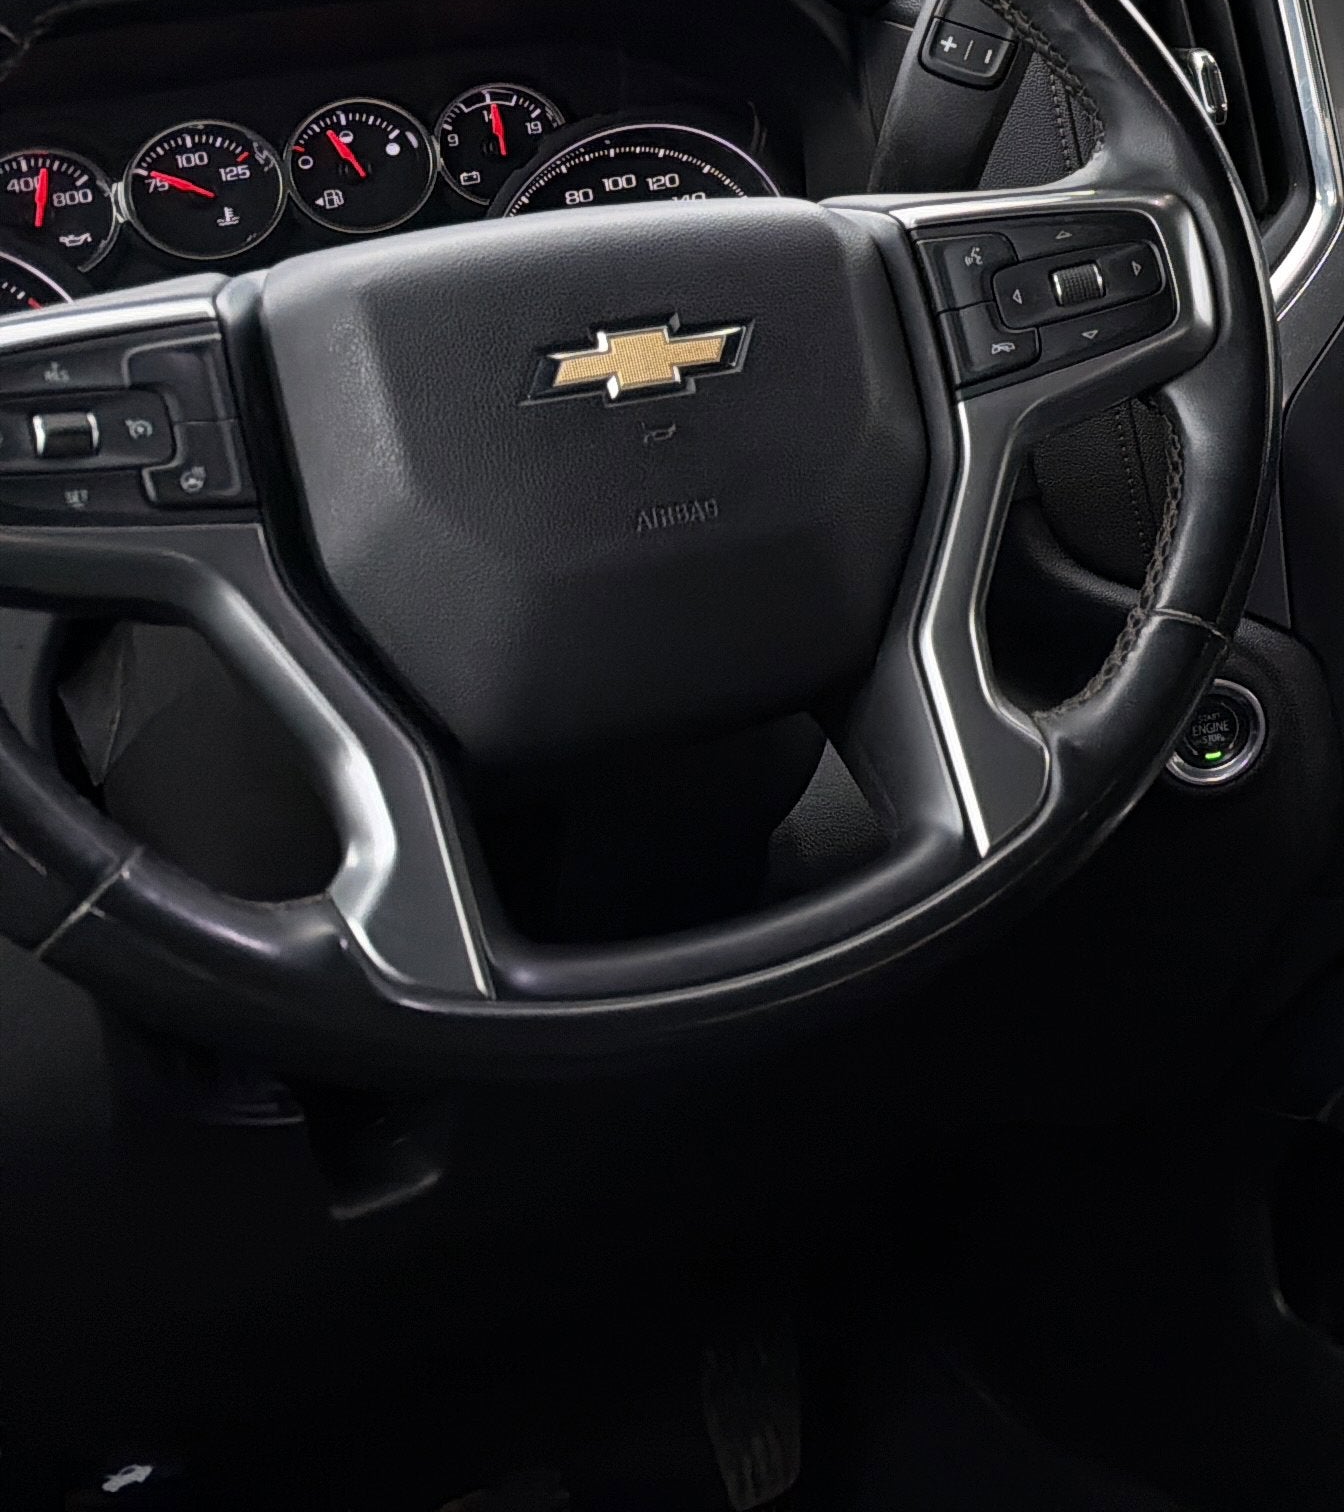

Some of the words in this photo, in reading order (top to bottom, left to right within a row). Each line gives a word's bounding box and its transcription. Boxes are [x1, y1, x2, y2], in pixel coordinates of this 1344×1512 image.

[525, 121, 542, 135] 19
[447, 133, 459, 147] 9
[175, 151, 209, 169] 100
[219, 164, 251, 182] 125
[145, 178, 170, 194] 75
[602, 173, 637, 192] 100
[646, 173, 680, 192] 120
[52, 189, 93, 208] 800
[565, 189, 595, 206] 80
[637, 498, 719, 533] AIRBAG
[1192, 720, 1231, 737] ENGINE
[1202, 733, 1222, 745] STOP
